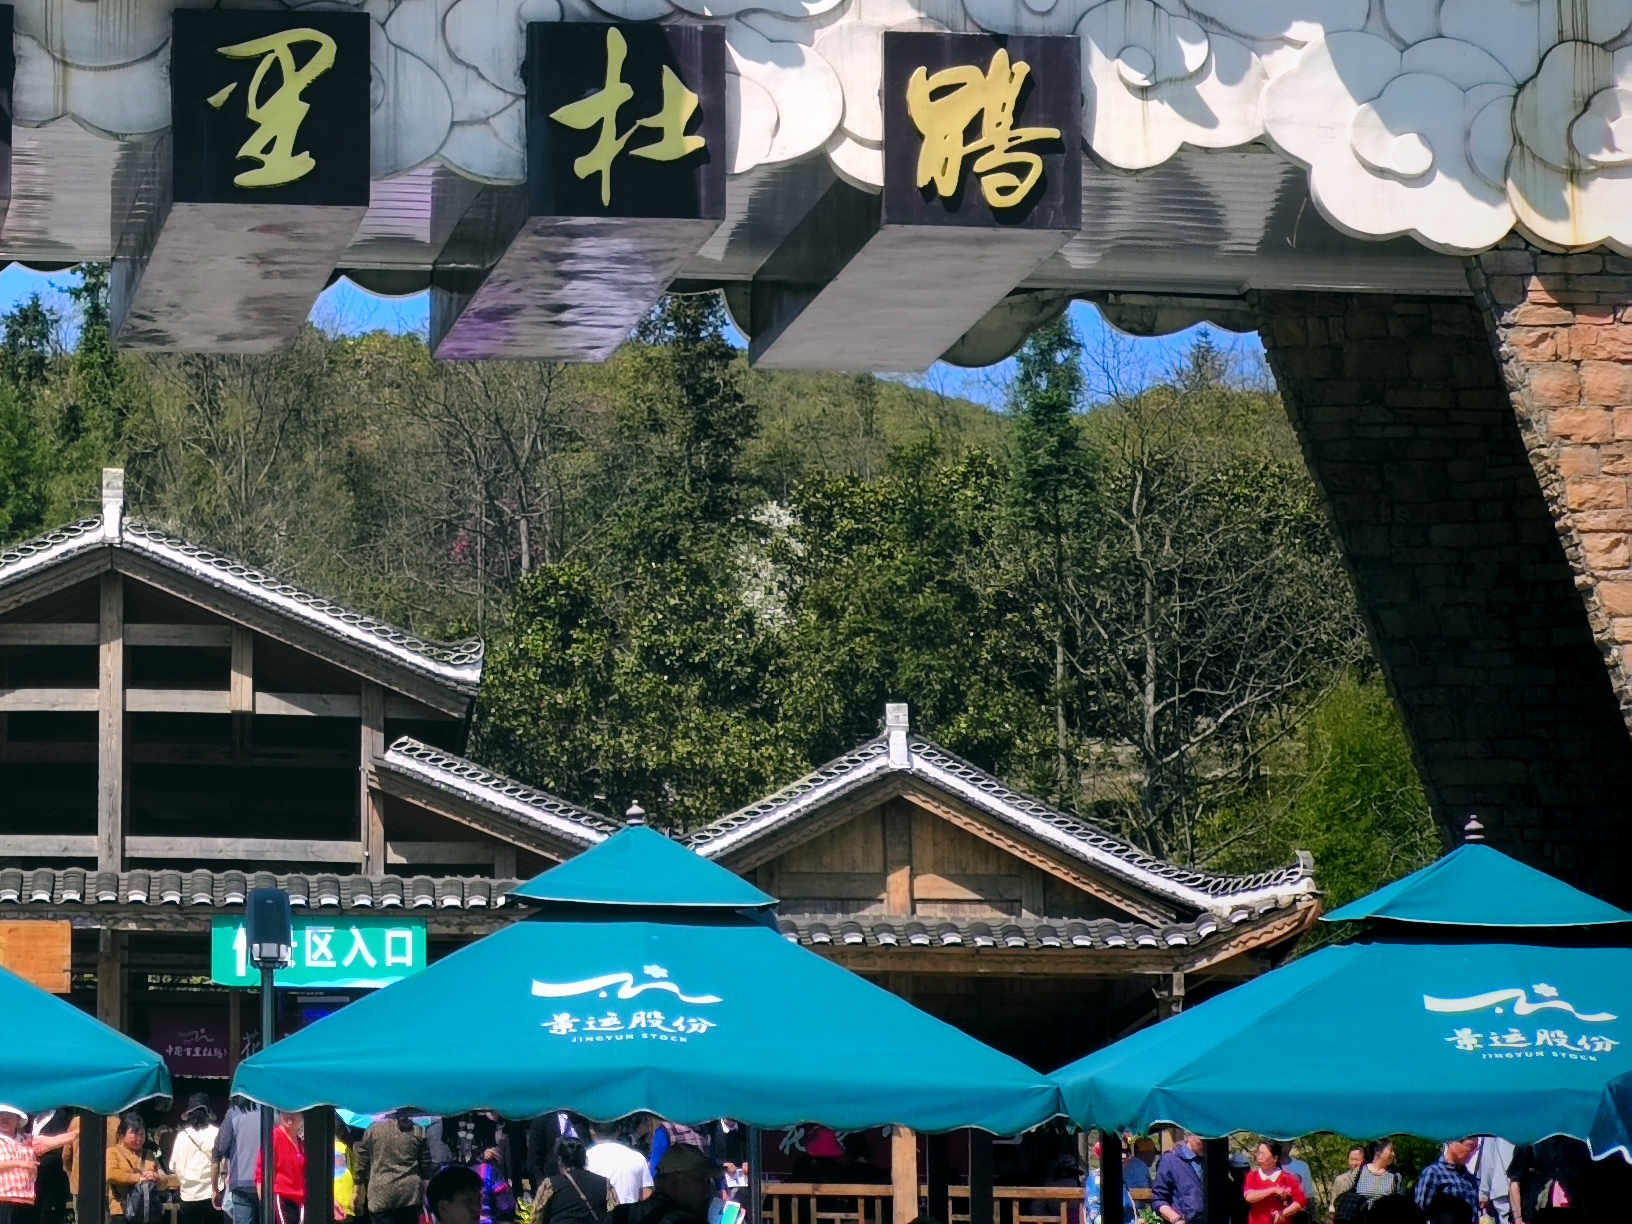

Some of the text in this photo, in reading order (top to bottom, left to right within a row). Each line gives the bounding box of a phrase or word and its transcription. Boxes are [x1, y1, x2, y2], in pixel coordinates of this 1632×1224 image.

[280, 924, 414, 968] 区入口
[539, 1010, 717, 1035] 景运股份
[571, 1033, 687, 1044] JINGYUN STOCK
[1444, 1027, 1620, 1051] 景运股份
